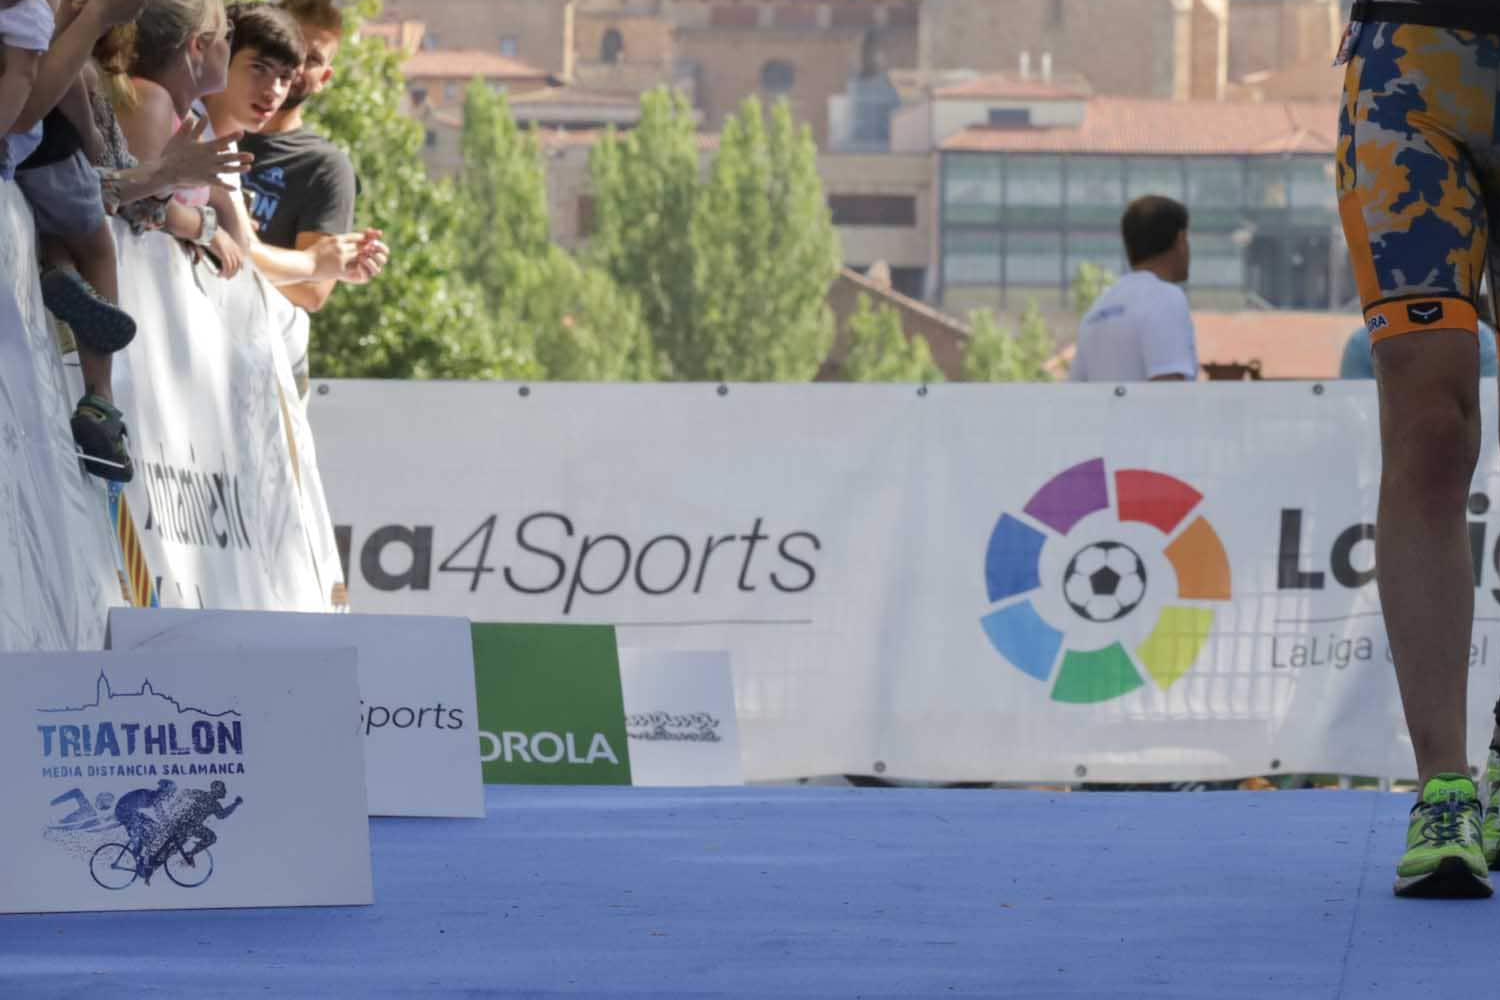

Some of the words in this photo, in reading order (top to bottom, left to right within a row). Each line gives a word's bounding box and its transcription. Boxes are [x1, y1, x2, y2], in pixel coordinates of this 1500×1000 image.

[334, 511, 821, 615] a4Sports
[1271, 633, 1373, 671] LaLiga
[360, 699, 465, 736] ports
[37, 720, 244, 758] TRIATHLON
[42, 765, 82, 778] MEDIA
[87, 764, 157, 778] DISTANCIA
[162, 762, 245, 776] SALAMANCA
